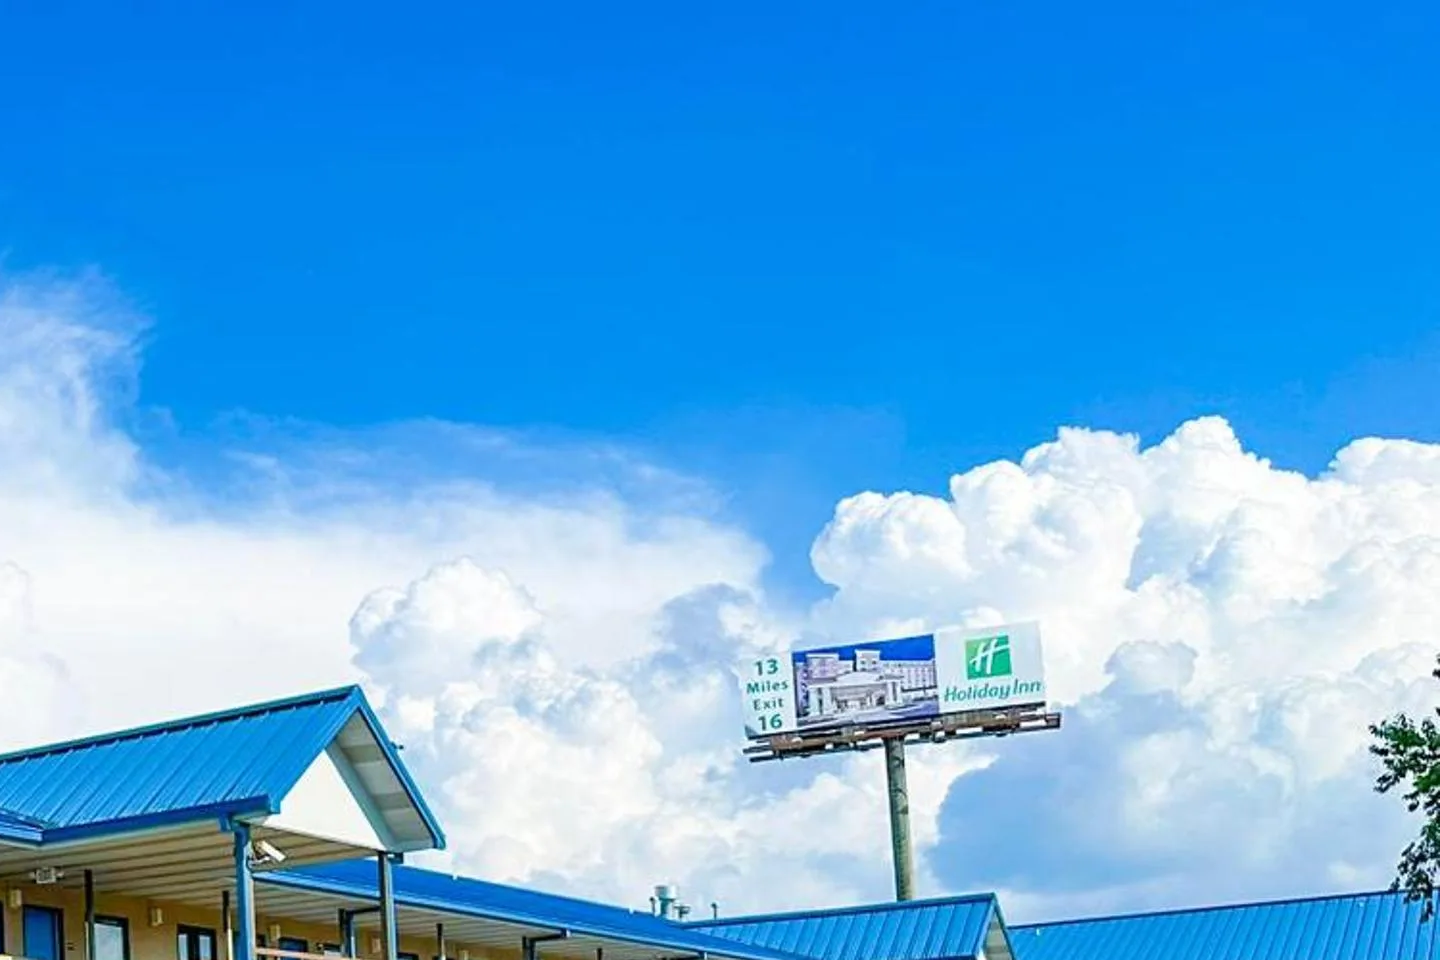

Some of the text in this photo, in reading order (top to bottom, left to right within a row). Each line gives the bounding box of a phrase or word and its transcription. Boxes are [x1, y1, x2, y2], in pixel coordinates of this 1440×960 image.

[754, 659, 779, 676] 13
[746, 680, 788, 694] Miles
[944, 678, 1042, 702] Holiday Inn
[753, 698, 783, 711] Exit
[758, 714, 783, 731] 16
